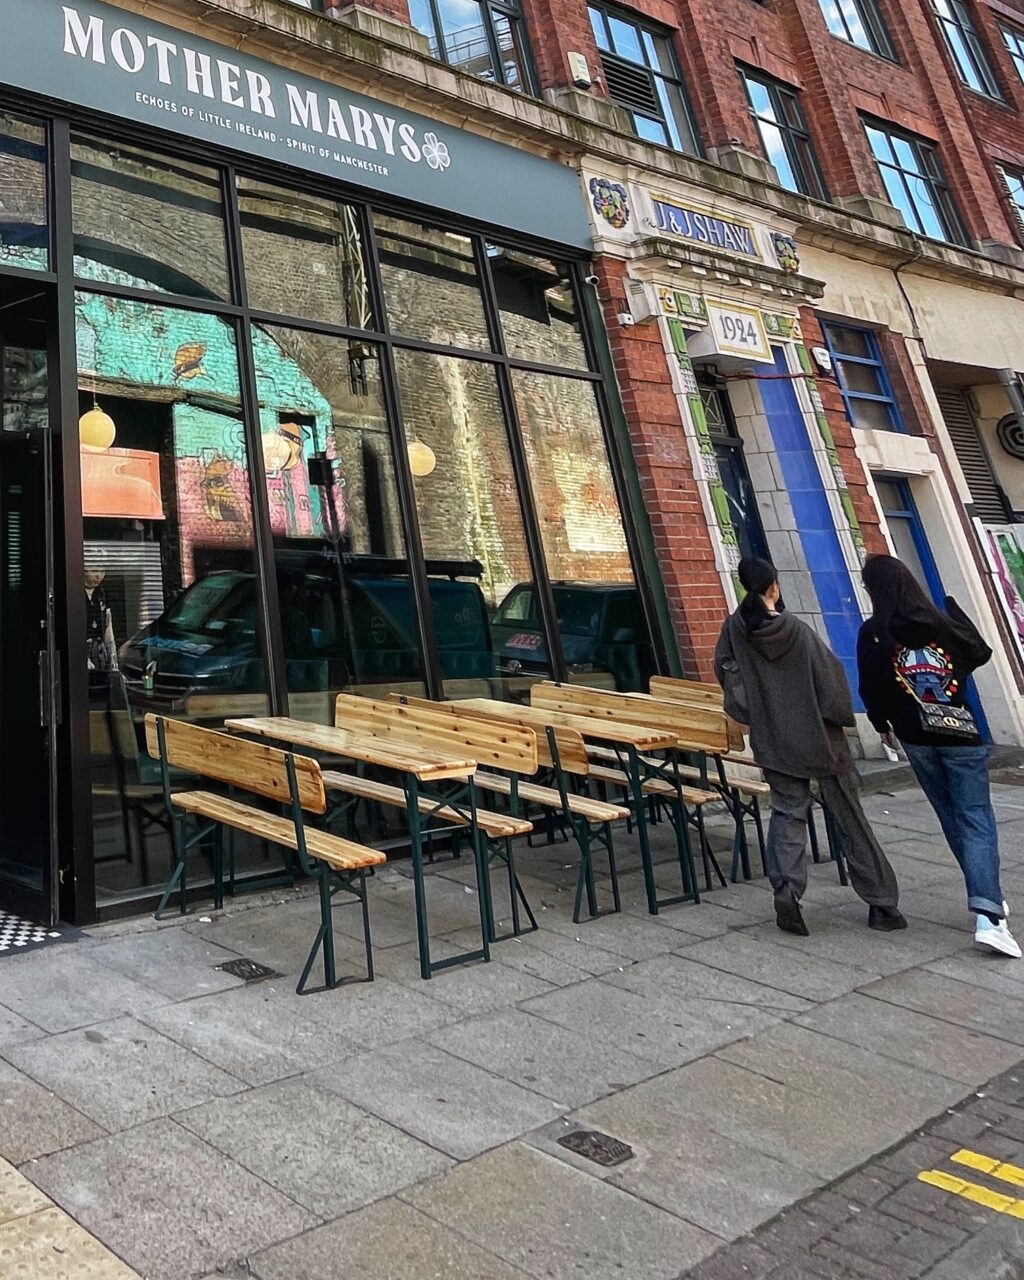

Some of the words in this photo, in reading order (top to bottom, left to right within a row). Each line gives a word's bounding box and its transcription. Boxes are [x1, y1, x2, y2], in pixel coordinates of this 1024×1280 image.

[61, 6, 276, 118] MOTHER
[285, 83, 422, 163] MARYS
[135, 91, 177, 113] ECHOES
[181, 106, 194, 117] OF
[198, 111, 231, 129] LITTLE
[236, 122, 276, 142] IRELAND
[287, 138, 315, 154] SPIRIT
[319, 148, 330, 158] OF
[334, 153, 389, 176] MANCHESTER
[693, 214, 749, 253] SHAW
[719, 315, 757, 345] 1924
